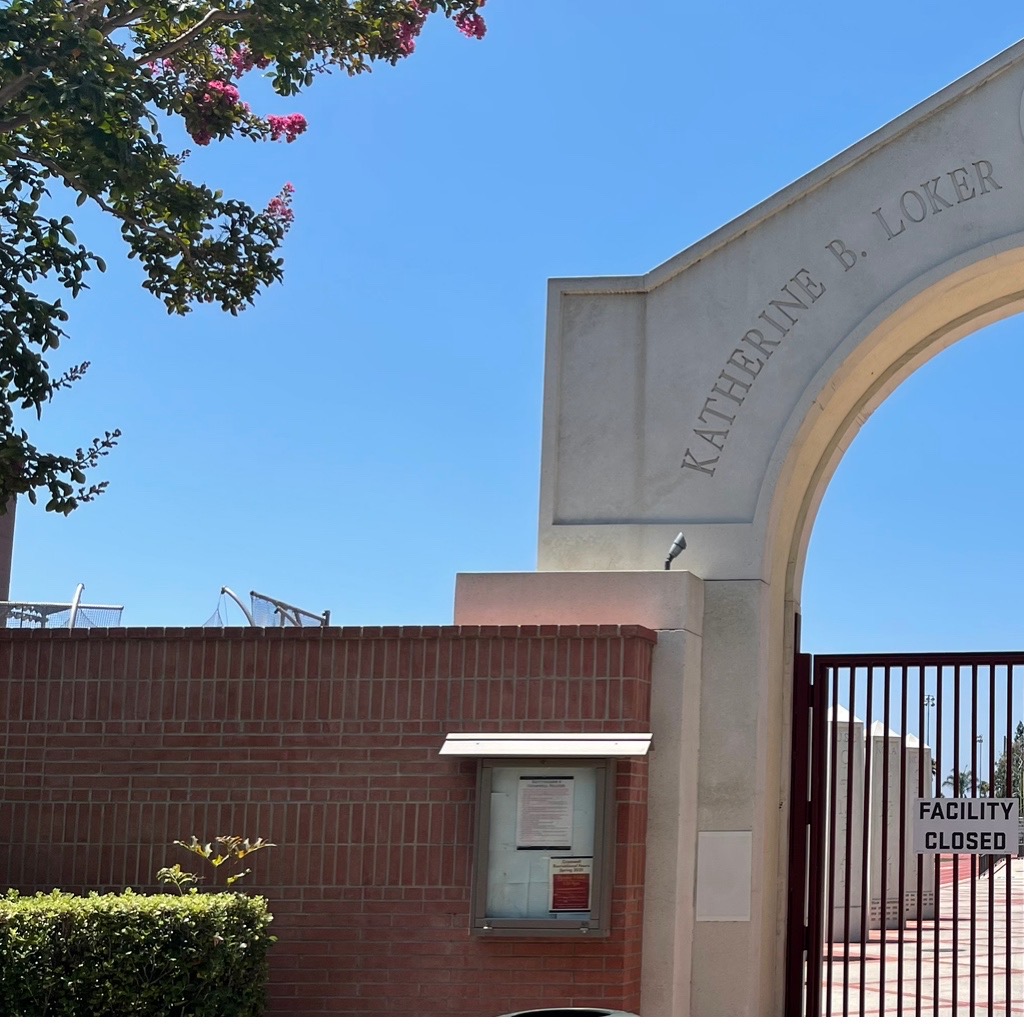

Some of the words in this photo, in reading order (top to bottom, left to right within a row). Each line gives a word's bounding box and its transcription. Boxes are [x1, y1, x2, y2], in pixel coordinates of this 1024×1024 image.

[681, 268, 827, 477] KATHERINE
[825, 238, 868, 272] B.
[872, 159, 1003, 241] LOKER
[920, 801, 1014, 820] FACILITY
[925, 831, 1006, 850] CLOSED
